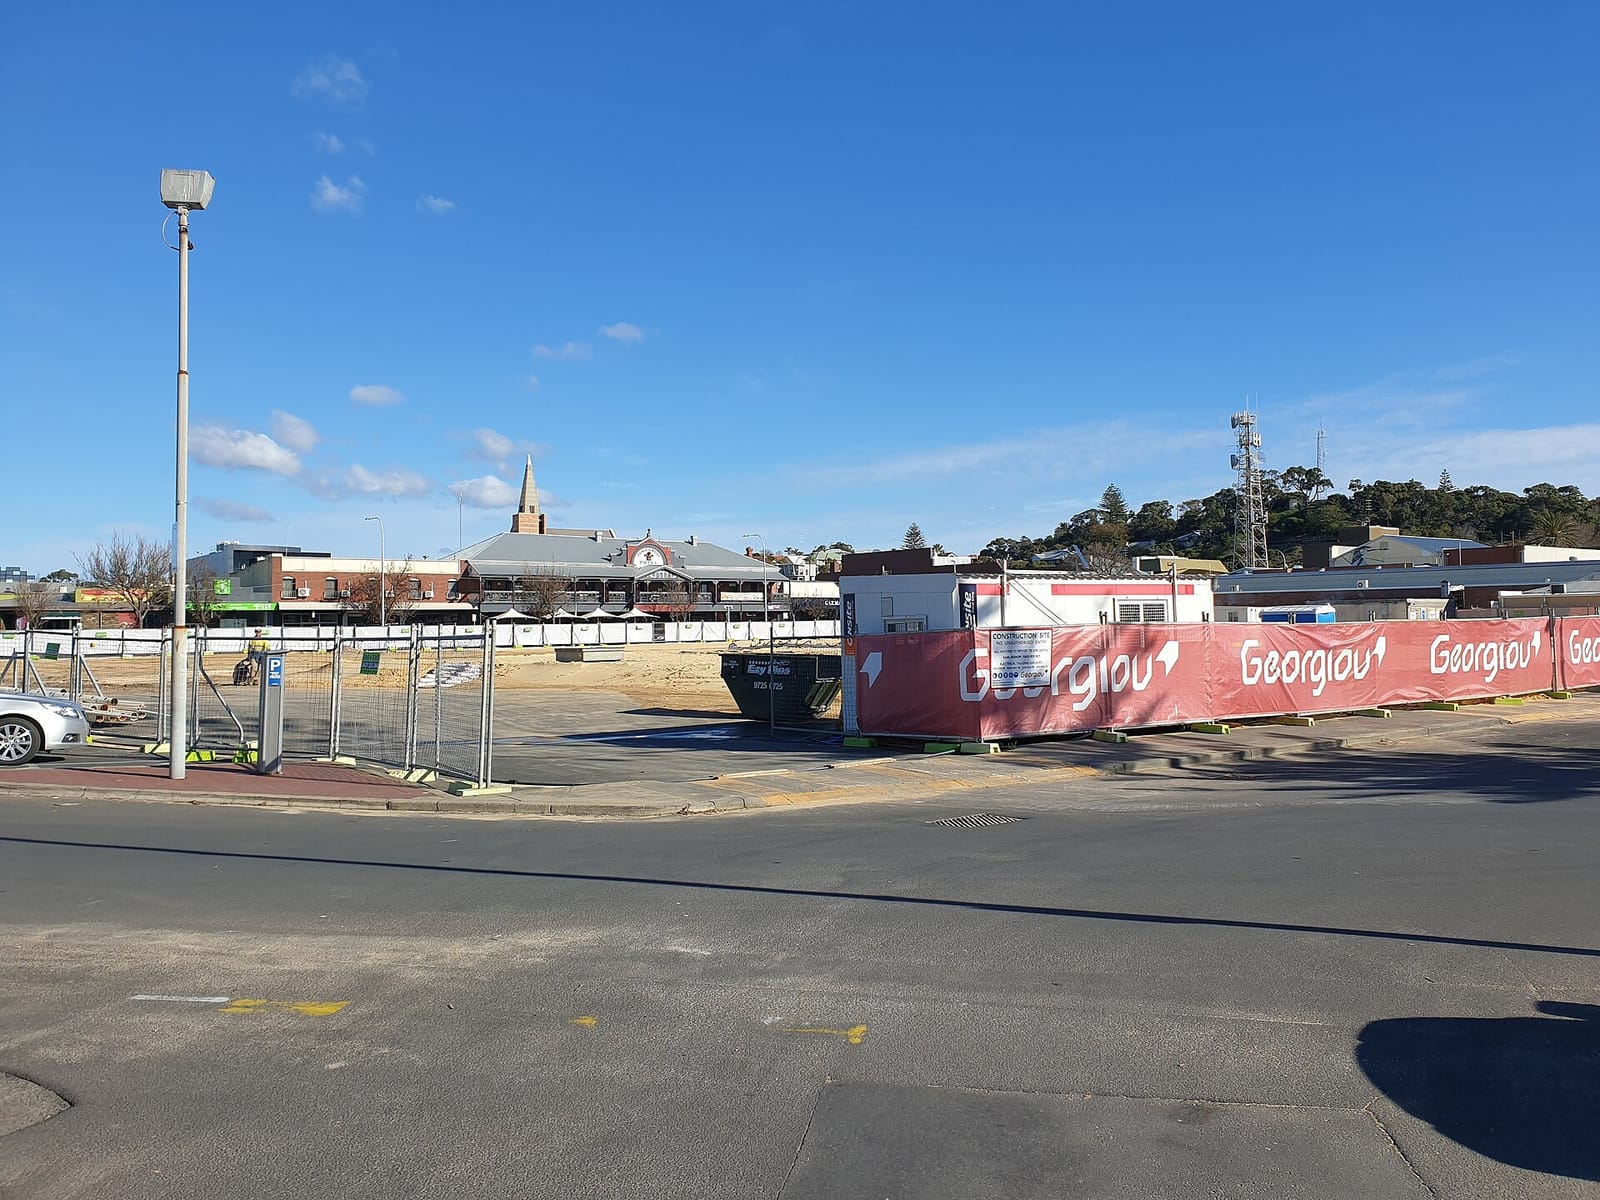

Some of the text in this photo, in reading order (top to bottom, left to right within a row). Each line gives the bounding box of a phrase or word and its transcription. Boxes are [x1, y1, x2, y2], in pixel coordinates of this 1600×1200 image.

[993, 632, 1038, 640] CONSTRUCTION
[1430, 635, 1532, 683] Georgiou
[270, 659, 281, 671] P
[747, 664, 767, 675] Ezy
[1241, 639, 1371, 697] Georgiou
[959, 648, 1153, 712] Grgiou
[1020, 671, 1045, 679] Georgiou
[753, 681, 768, 689] 9725
